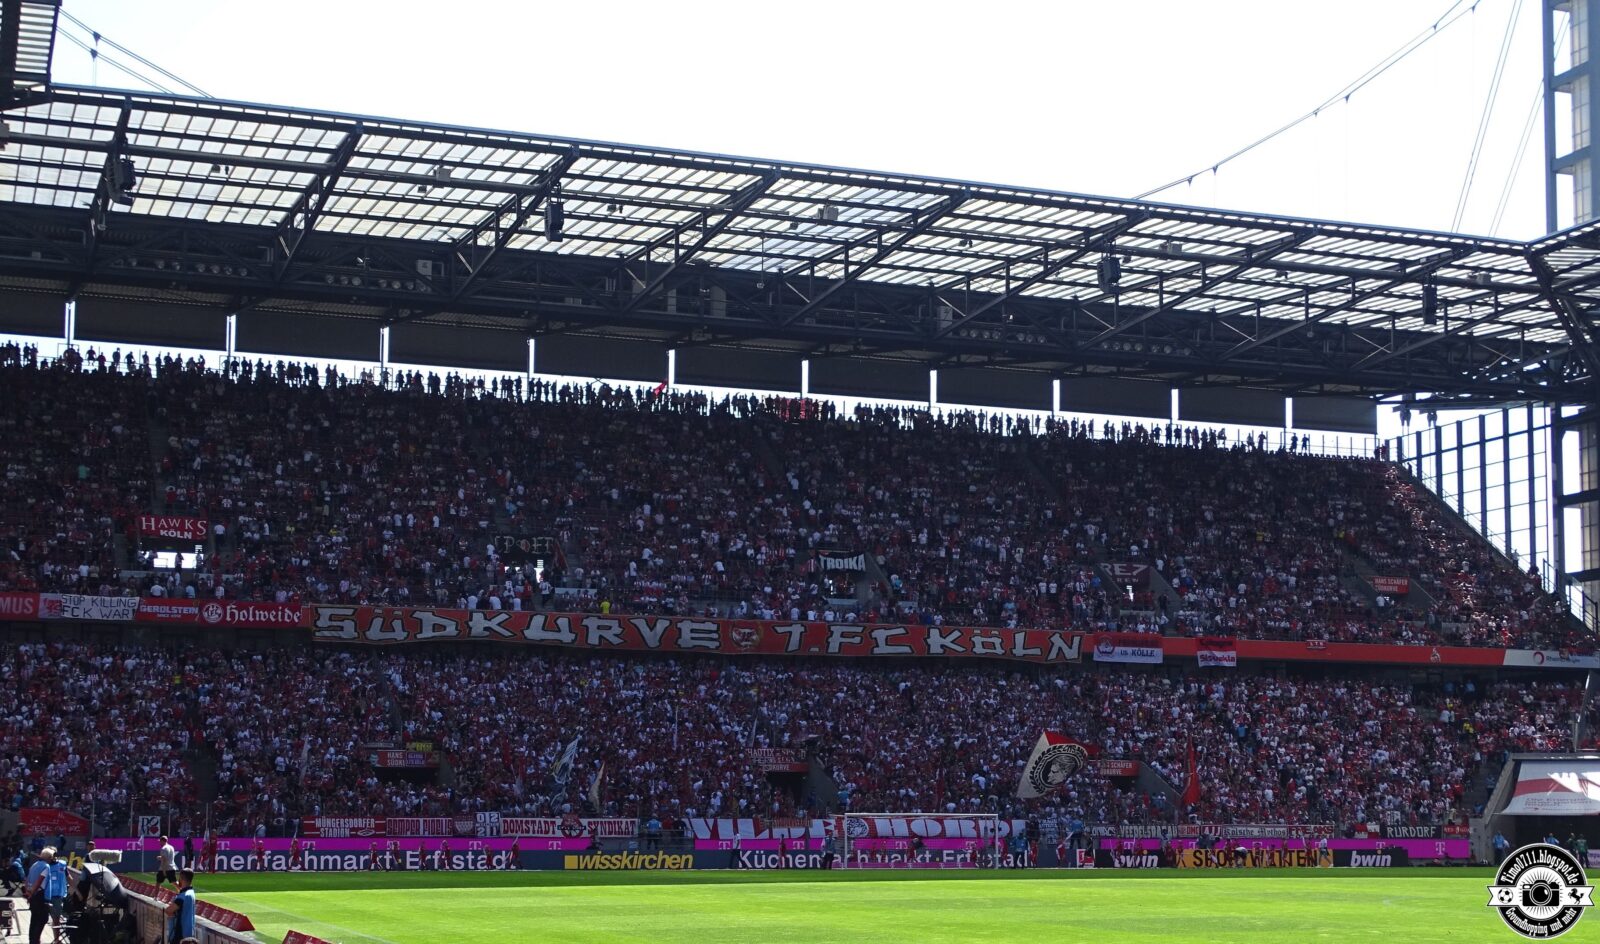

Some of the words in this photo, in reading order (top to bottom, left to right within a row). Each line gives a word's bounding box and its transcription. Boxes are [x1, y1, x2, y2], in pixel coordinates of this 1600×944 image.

[141, 516, 207, 536] HAWKS
[159, 529, 192, 539] KÖLN
[819, 554, 866, 571] TROIKA
[91, 597, 137, 608] KILLING
[225, 603, 300, 624] Holweide
[313, 605, 721, 649] SÜDKURVE
[924, 628, 1082, 661] KÖLN
[315, 816, 375, 829] MÜNGERSDORFER
[502, 820, 557, 835] DOMSTADT
[319, 827, 350, 838] STADION
[1386, 826, 1437, 838] RURDORF
[579, 850, 694, 870] wisskirchen
[1350, 850, 1392, 867] bwin
